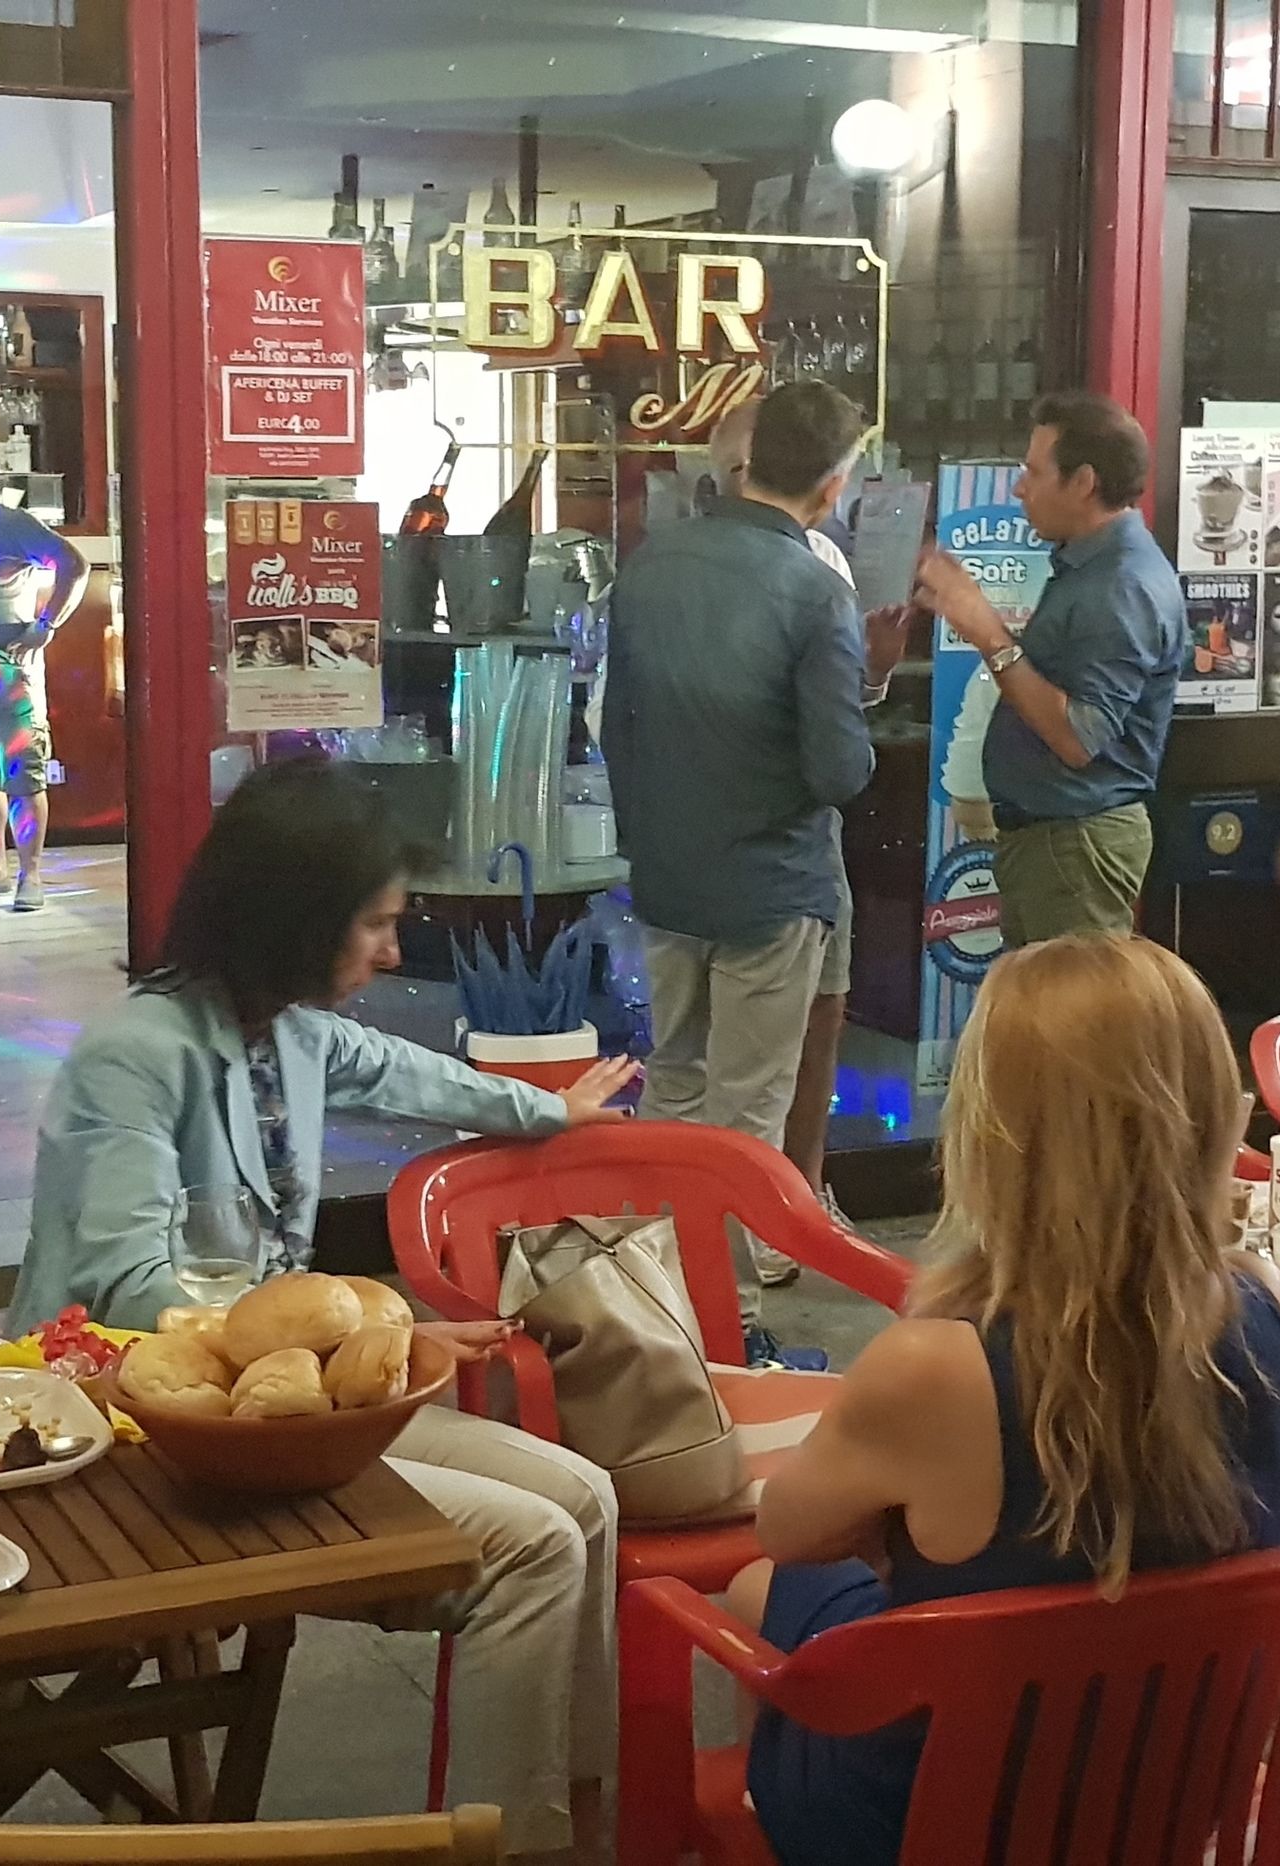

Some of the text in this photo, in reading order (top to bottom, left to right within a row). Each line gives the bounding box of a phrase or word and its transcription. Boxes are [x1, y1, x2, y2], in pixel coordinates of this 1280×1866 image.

[254, 289, 322, 313] Mixer
[462, 246, 768, 355] BAR
[233, 377, 344, 391] APERICENA BUFFET
[292, 391, 314, 403] SET
[311, 536, 363, 554] Mixer
[960, 556, 1028, 584] Soft
[1187, 583, 1251, 600] SMOOTHIES
